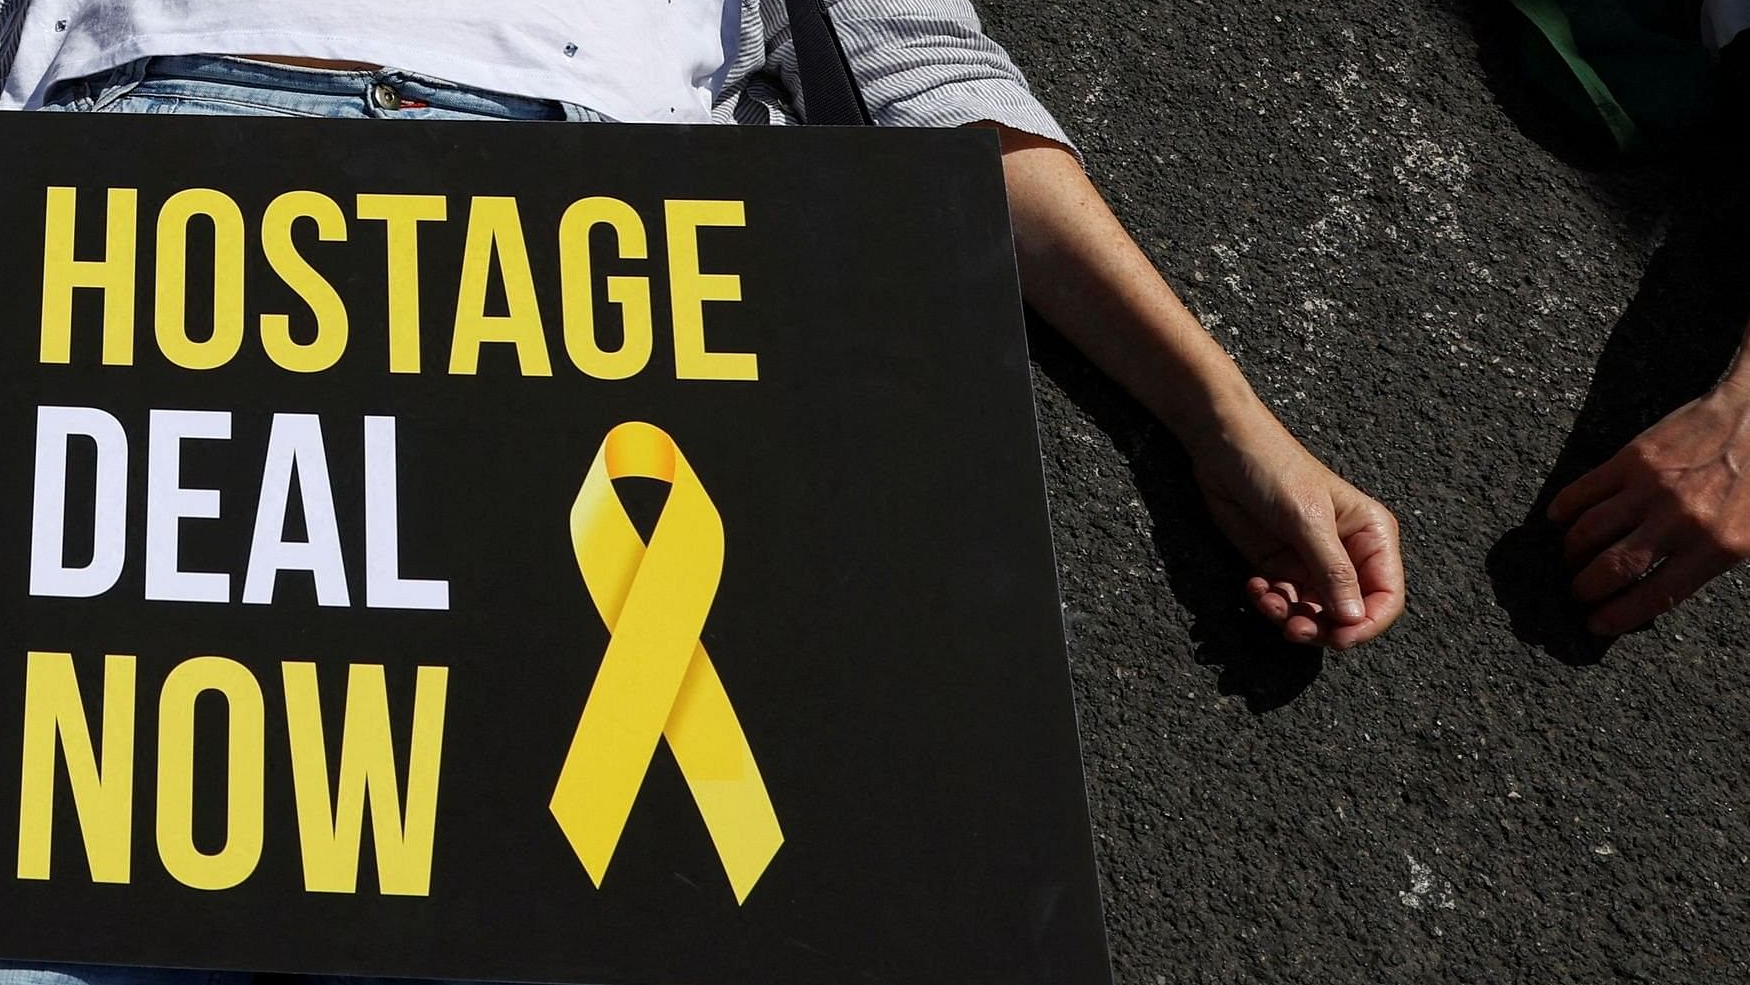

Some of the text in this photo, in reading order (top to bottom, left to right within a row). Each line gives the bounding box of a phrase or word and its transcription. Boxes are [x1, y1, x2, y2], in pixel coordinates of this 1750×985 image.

[40, 188, 759, 381] HOSTAGE
[29, 406, 450, 610] DEAL
[17, 651, 449, 897] NOW
